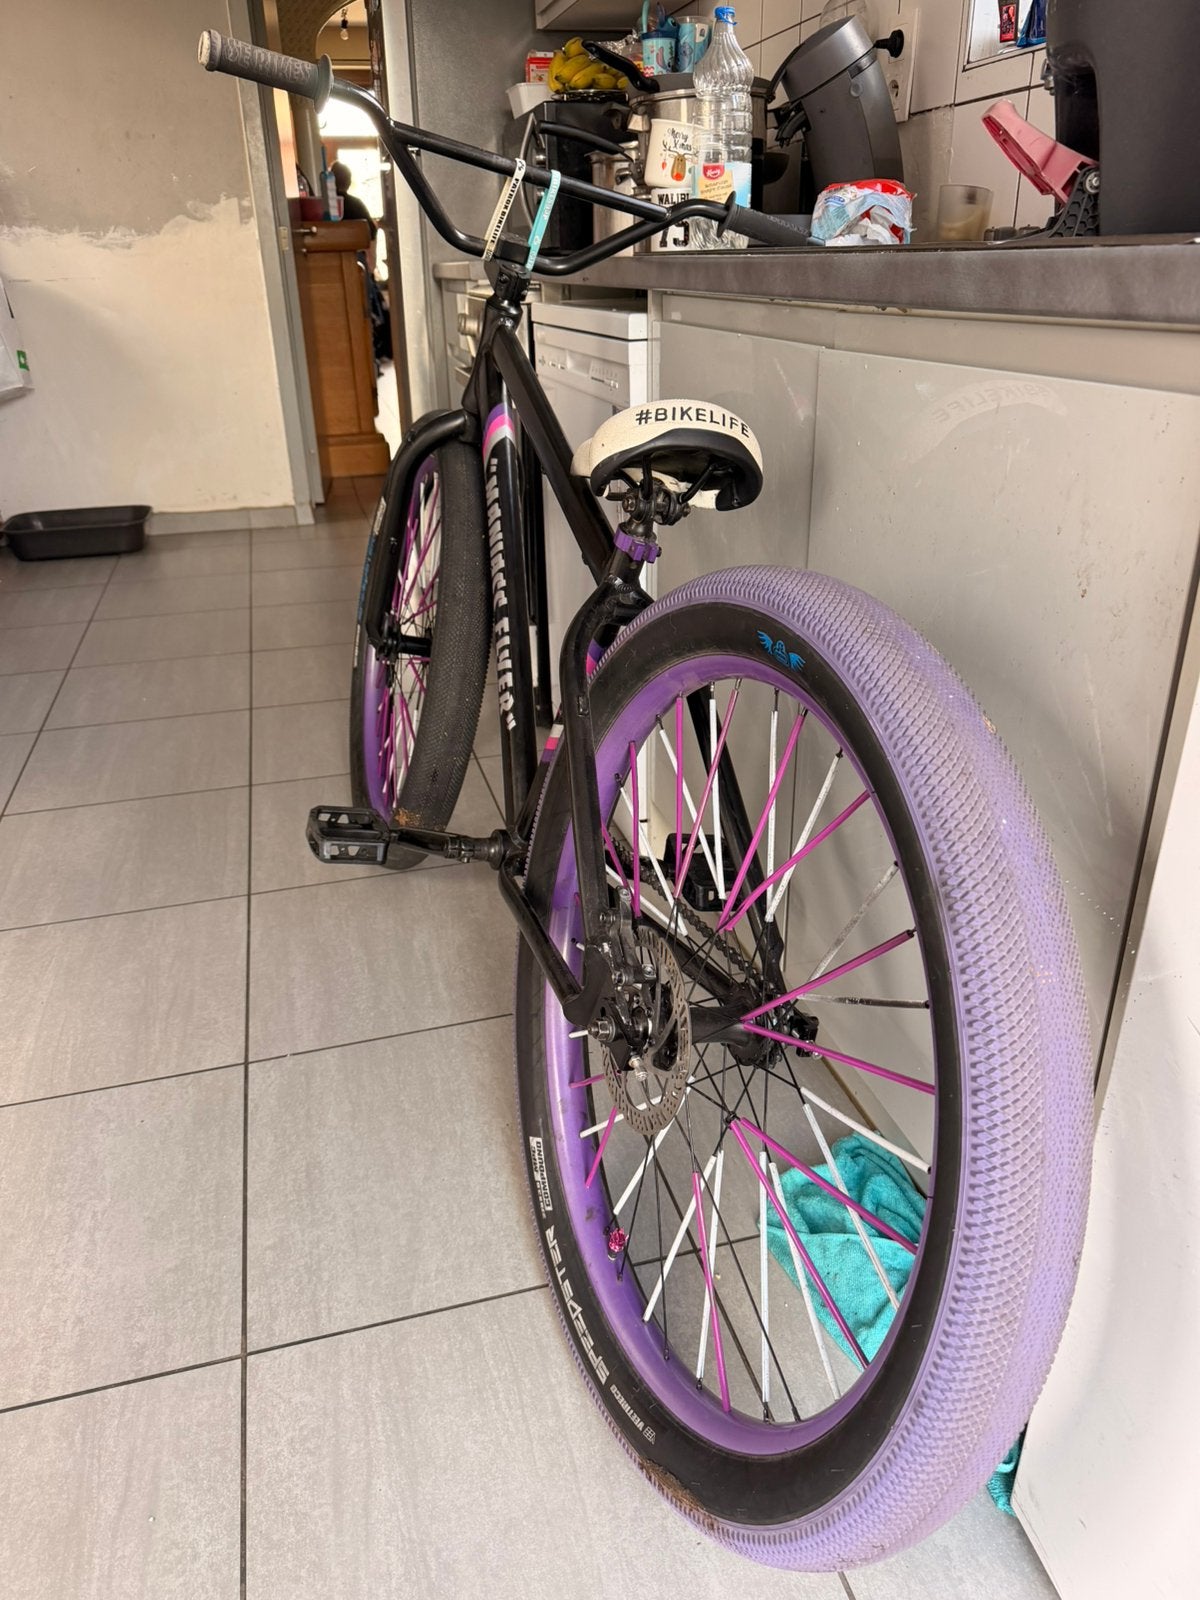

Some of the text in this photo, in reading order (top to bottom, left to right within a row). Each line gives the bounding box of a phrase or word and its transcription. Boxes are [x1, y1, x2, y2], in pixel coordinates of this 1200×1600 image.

[635, 406, 750, 438] #BIKELIFE
[536, 1141, 551, 1207] COMPOUND
[545, 1224, 610, 1386] SPEEDSTER
